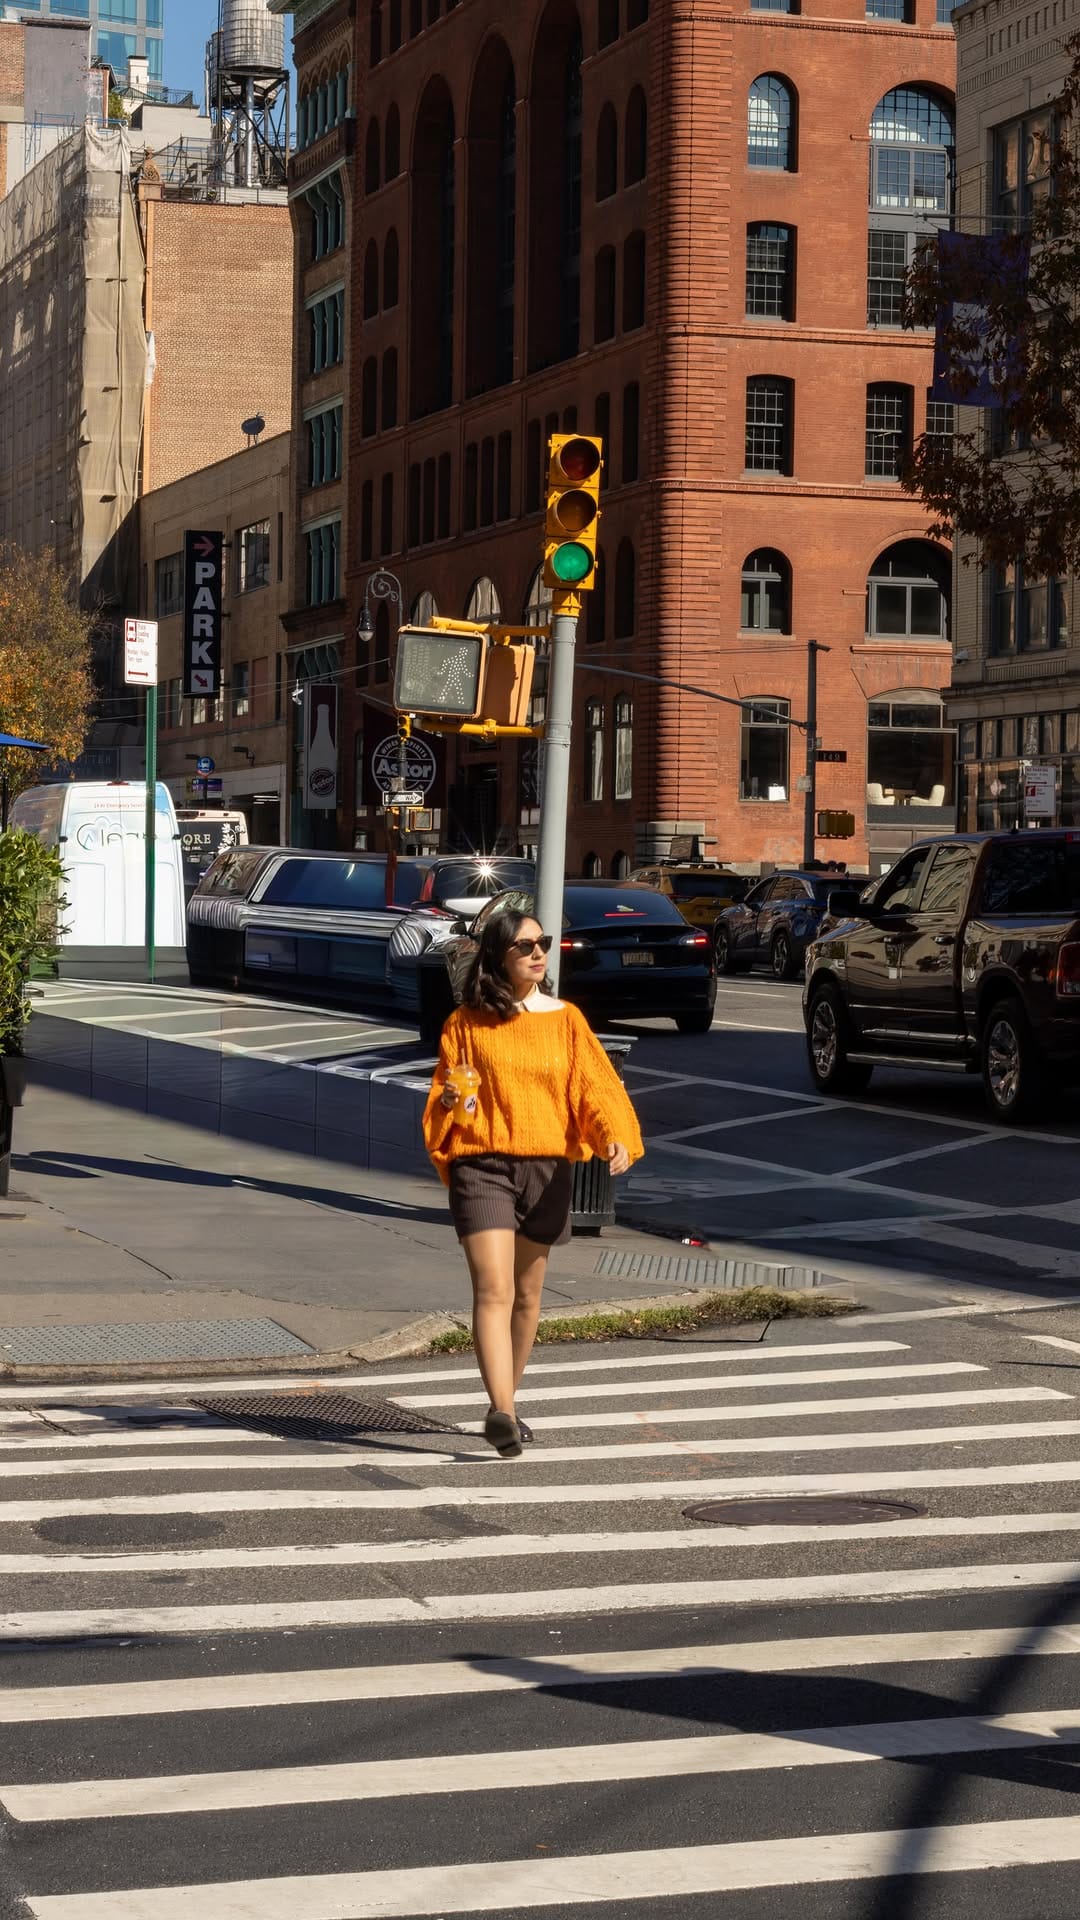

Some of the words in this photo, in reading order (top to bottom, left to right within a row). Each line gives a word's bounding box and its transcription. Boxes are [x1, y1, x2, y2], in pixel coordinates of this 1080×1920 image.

[950, 364, 1007, 385] YU
[191, 561, 217, 665] PARK
[406, 741, 428, 758] SPIRITS
[376, 758, 433, 778] Astor
